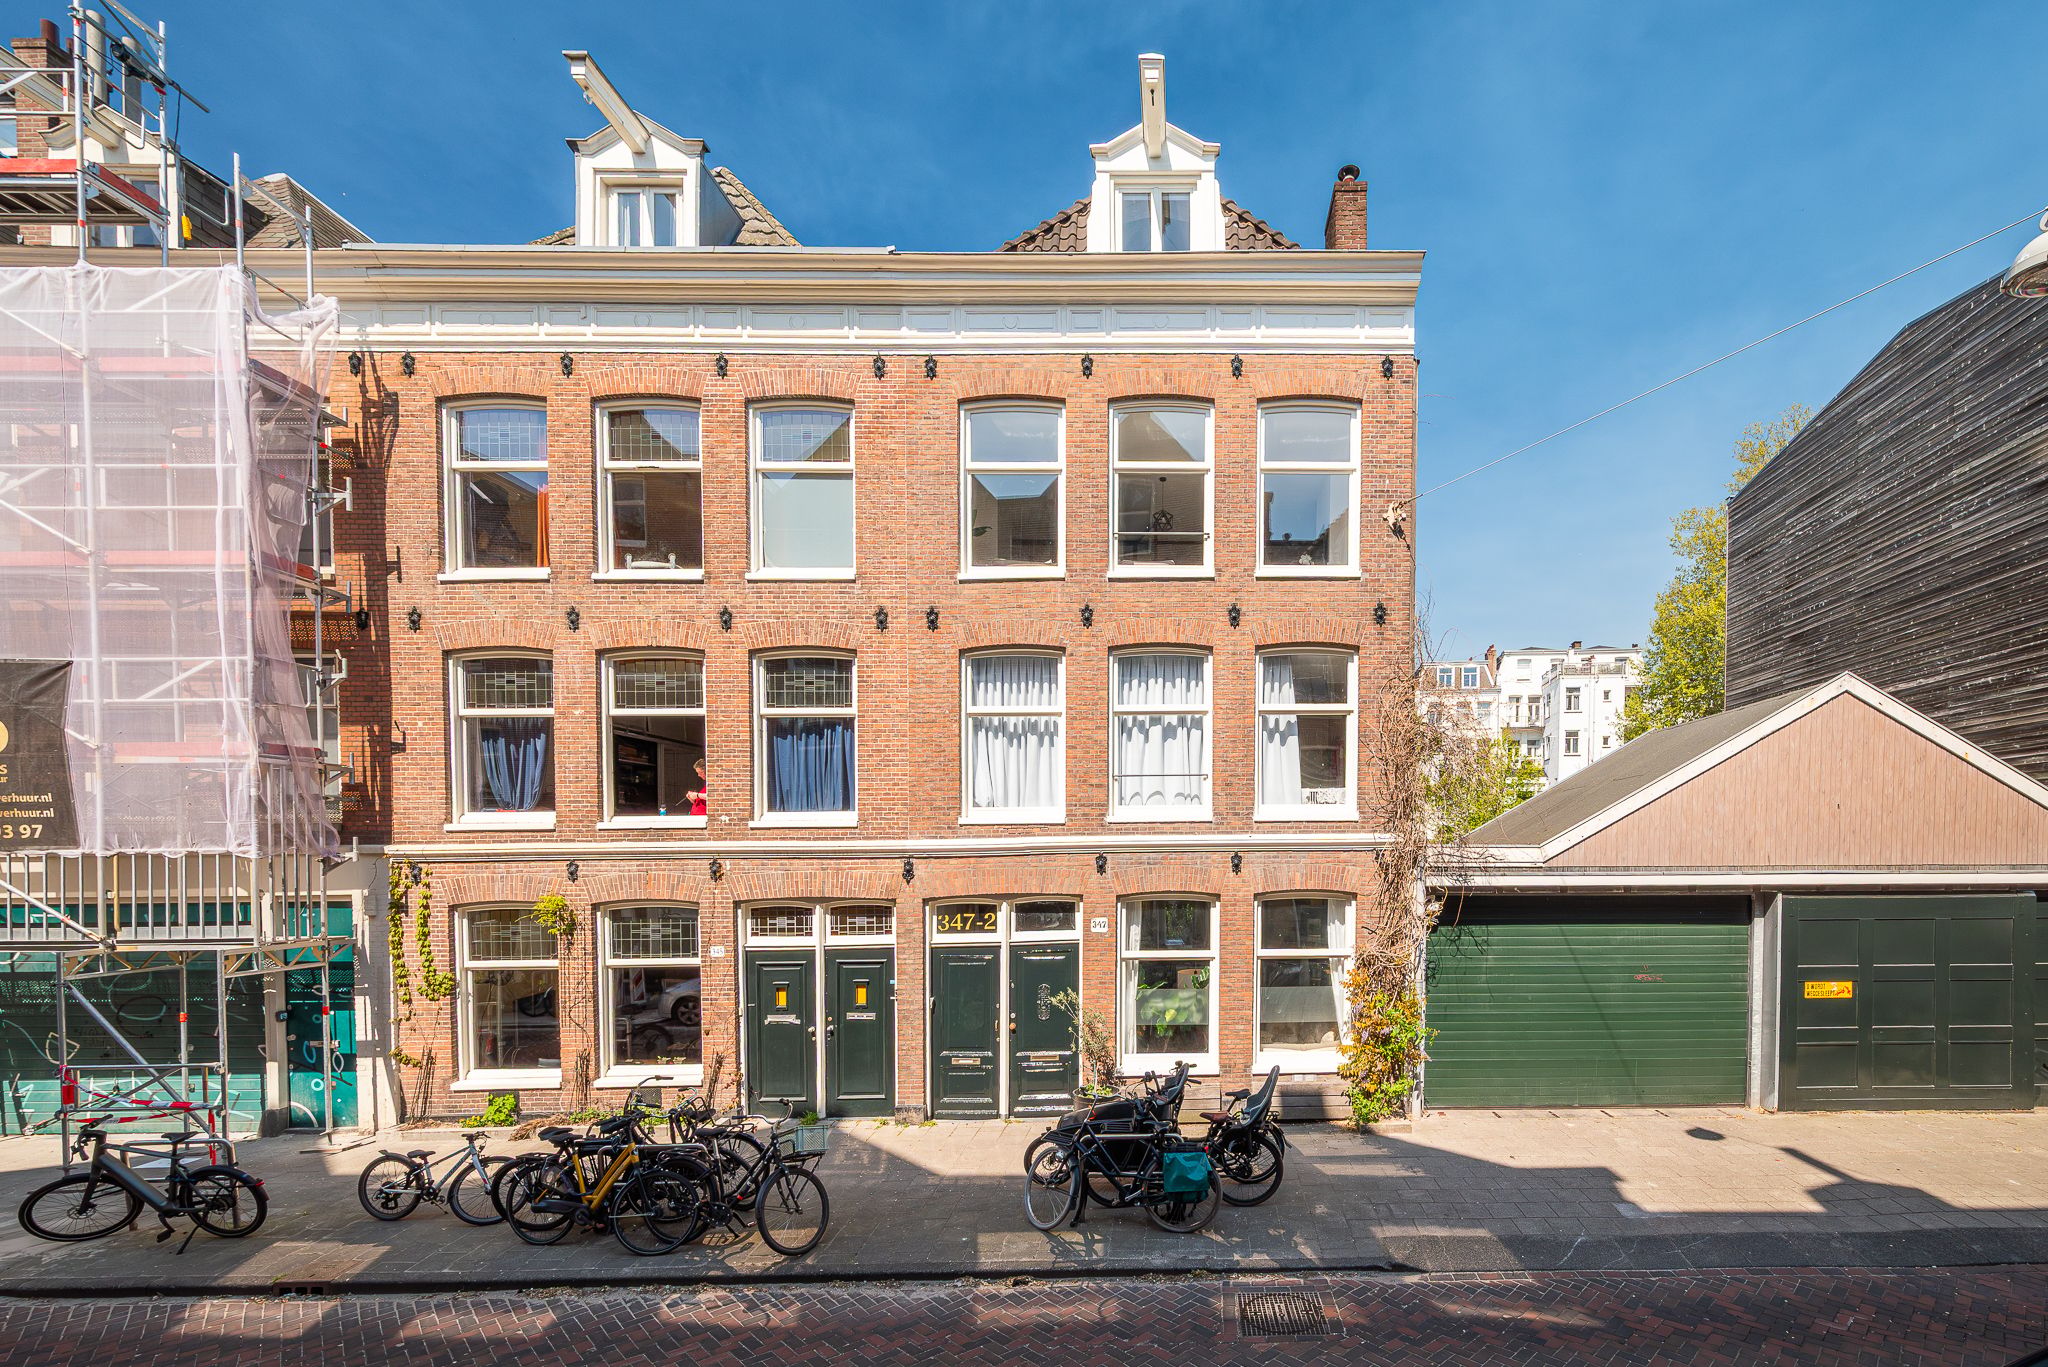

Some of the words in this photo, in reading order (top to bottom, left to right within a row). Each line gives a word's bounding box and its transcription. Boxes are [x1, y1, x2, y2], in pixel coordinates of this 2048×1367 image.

[0, 792, 53, 803] erhuur.nl
[0, 824, 14, 839] 3
[18, 824, 43, 839] 97
[937, 912, 996, 931] 347-2
[1092, 920, 1107, 929] 347
